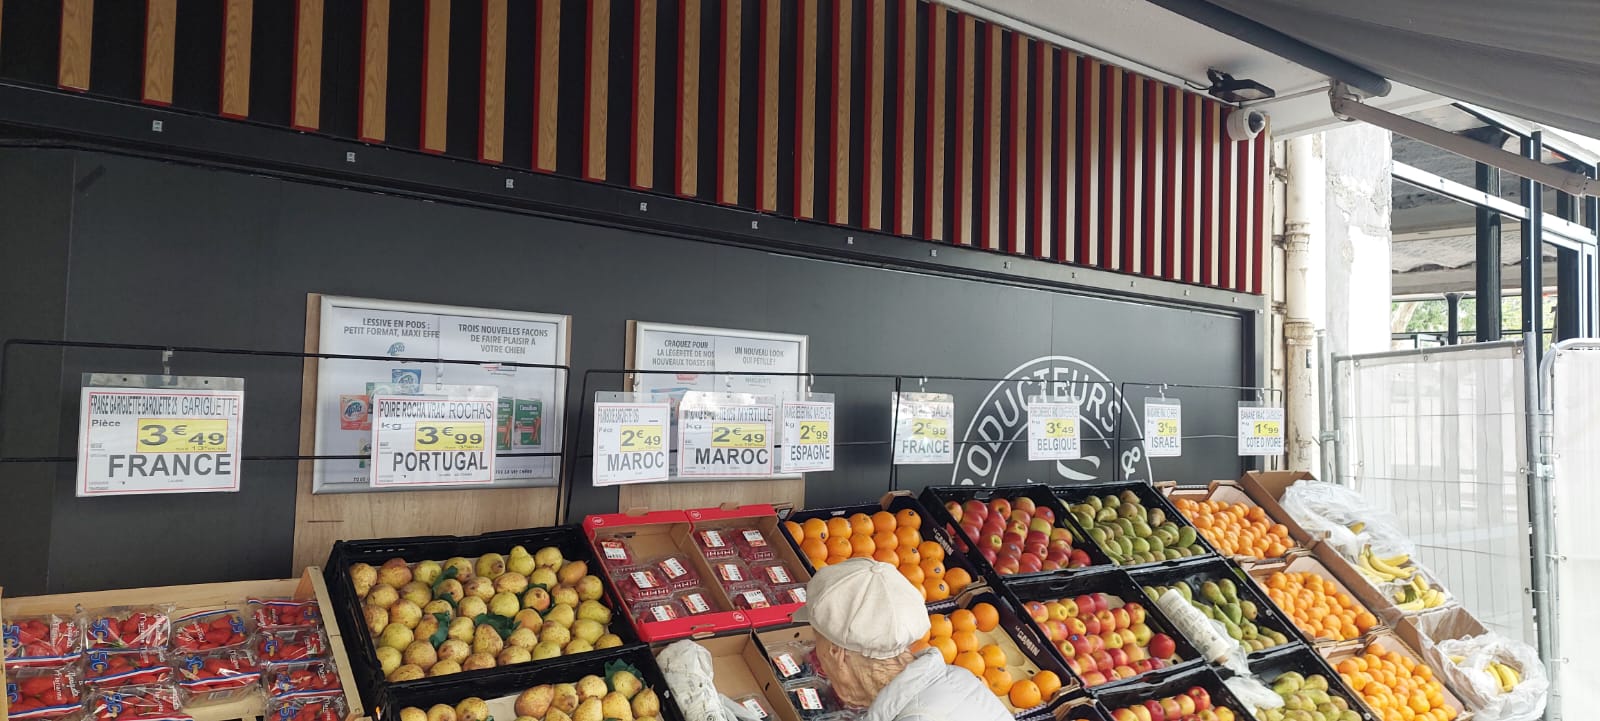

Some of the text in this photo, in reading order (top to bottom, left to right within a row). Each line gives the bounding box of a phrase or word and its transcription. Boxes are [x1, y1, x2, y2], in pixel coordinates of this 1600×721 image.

[363, 318, 392, 327] LESSIVE
[394, 320, 403, 328] EN
[405, 320, 426, 329] PODS
[458, 323, 479, 333] TROIS
[481, 325, 520, 336] NOUVELLES
[344, 326, 364, 335] PETIT
[367, 327, 400, 337] FORMAT,
[402, 329, 420, 338] MAXI
[471, 334, 480, 342] DE
[482, 335, 501, 344] FAIRE
[503, 336, 529, 346] PLAISIR
[664, 340, 708, 349] CRAQUEZ POUR
[481, 344, 526, 354] VOTRE CHIEN
[657, 348, 664, 357] LA
[735, 346, 742, 354] UN
[744, 347, 769, 357] NOUVEAU
[652, 357, 684, 366] NOUVEAUX
[181, 396, 238, 417] GARIGUETTE
[379, 401, 401, 418] POIRE
[402, 401, 426, 419] ROCHA
[427, 402, 446, 419] VRAC
[448, 402, 492, 420] ROCHAS
[91, 418, 121, 428] Pièce
[381, 422, 402, 431] kg
[902, 440, 950, 454] FRANCE
[1037, 438, 1077, 451] BELGIQUE
[1151, 436, 1179, 449] ISRAEL
[695, 447, 769, 465] MAROC
[790, 444, 830, 461] ESPAGNE
[108, 453, 232, 478] FRANCE
[393, 451, 488, 472] PORTUGAL
[607, 451, 665, 472] MAROC
[1121, 446, 1141, 480] &
